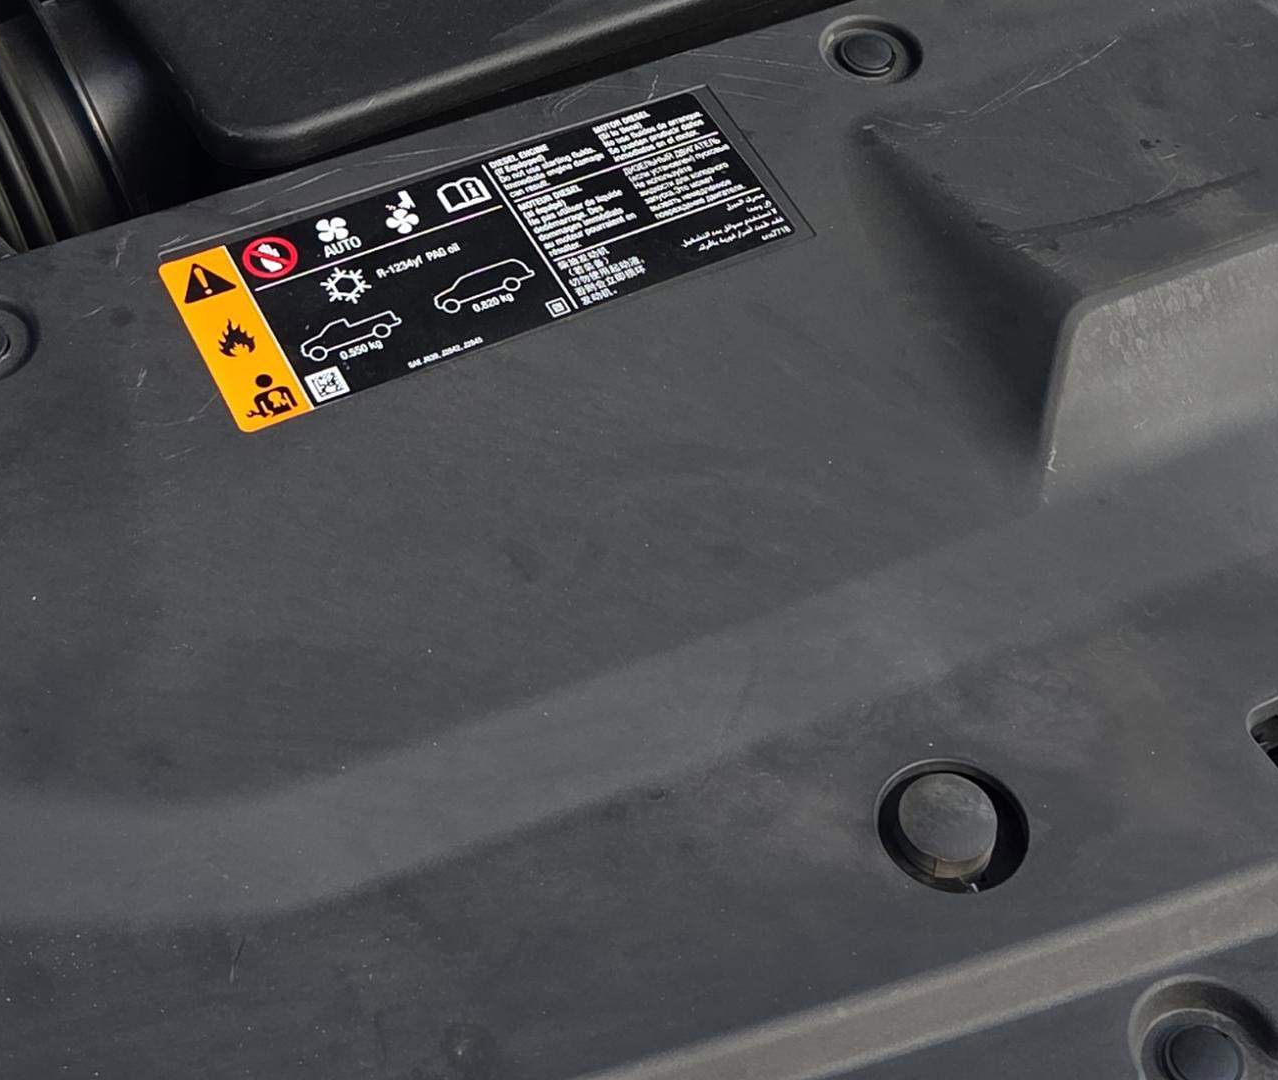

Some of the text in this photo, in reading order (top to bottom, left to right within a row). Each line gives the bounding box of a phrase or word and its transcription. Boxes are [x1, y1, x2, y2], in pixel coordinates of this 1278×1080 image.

[592, 111, 651, 134] MOTOR DIESEL
[602, 140, 615, 148] No
[615, 135, 630, 144] use
[630, 126, 657, 139] fluidos
[667, 111, 703, 127] arranque.
[620, 137, 649, 152] pueden
[648, 126, 680, 142] producir
[681, 119, 704, 131] daños
[488, 144, 549, 169] DIESEL ENGINE
[499, 175, 511, 183] Do
[511, 169, 526, 179] not
[525, 165, 541, 174] use
[541, 155, 572, 169] starting
[546, 163, 573, 176] engine
[573, 153, 605, 167] damage
[622, 137, 721, 176] ДИЗЕЛЬНЫЙ ДВИГАТЕЛЬ
[509, 180, 551, 198] can result.
[517, 184, 583, 211] MOTEUR DIESEL
[540, 212, 557, 224] pas
[584, 199, 596, 207] de
[586, 205, 604, 215] Des
[538, 222, 583, 242] dommages
[543, 212, 637, 250] au moteur pourraient en
[323, 235, 362, 258] AUTO
[376, 242, 461, 278] R-1234yf PAG oil
[500, 292, 515, 304] kg
[368, 337, 384, 350] kg
